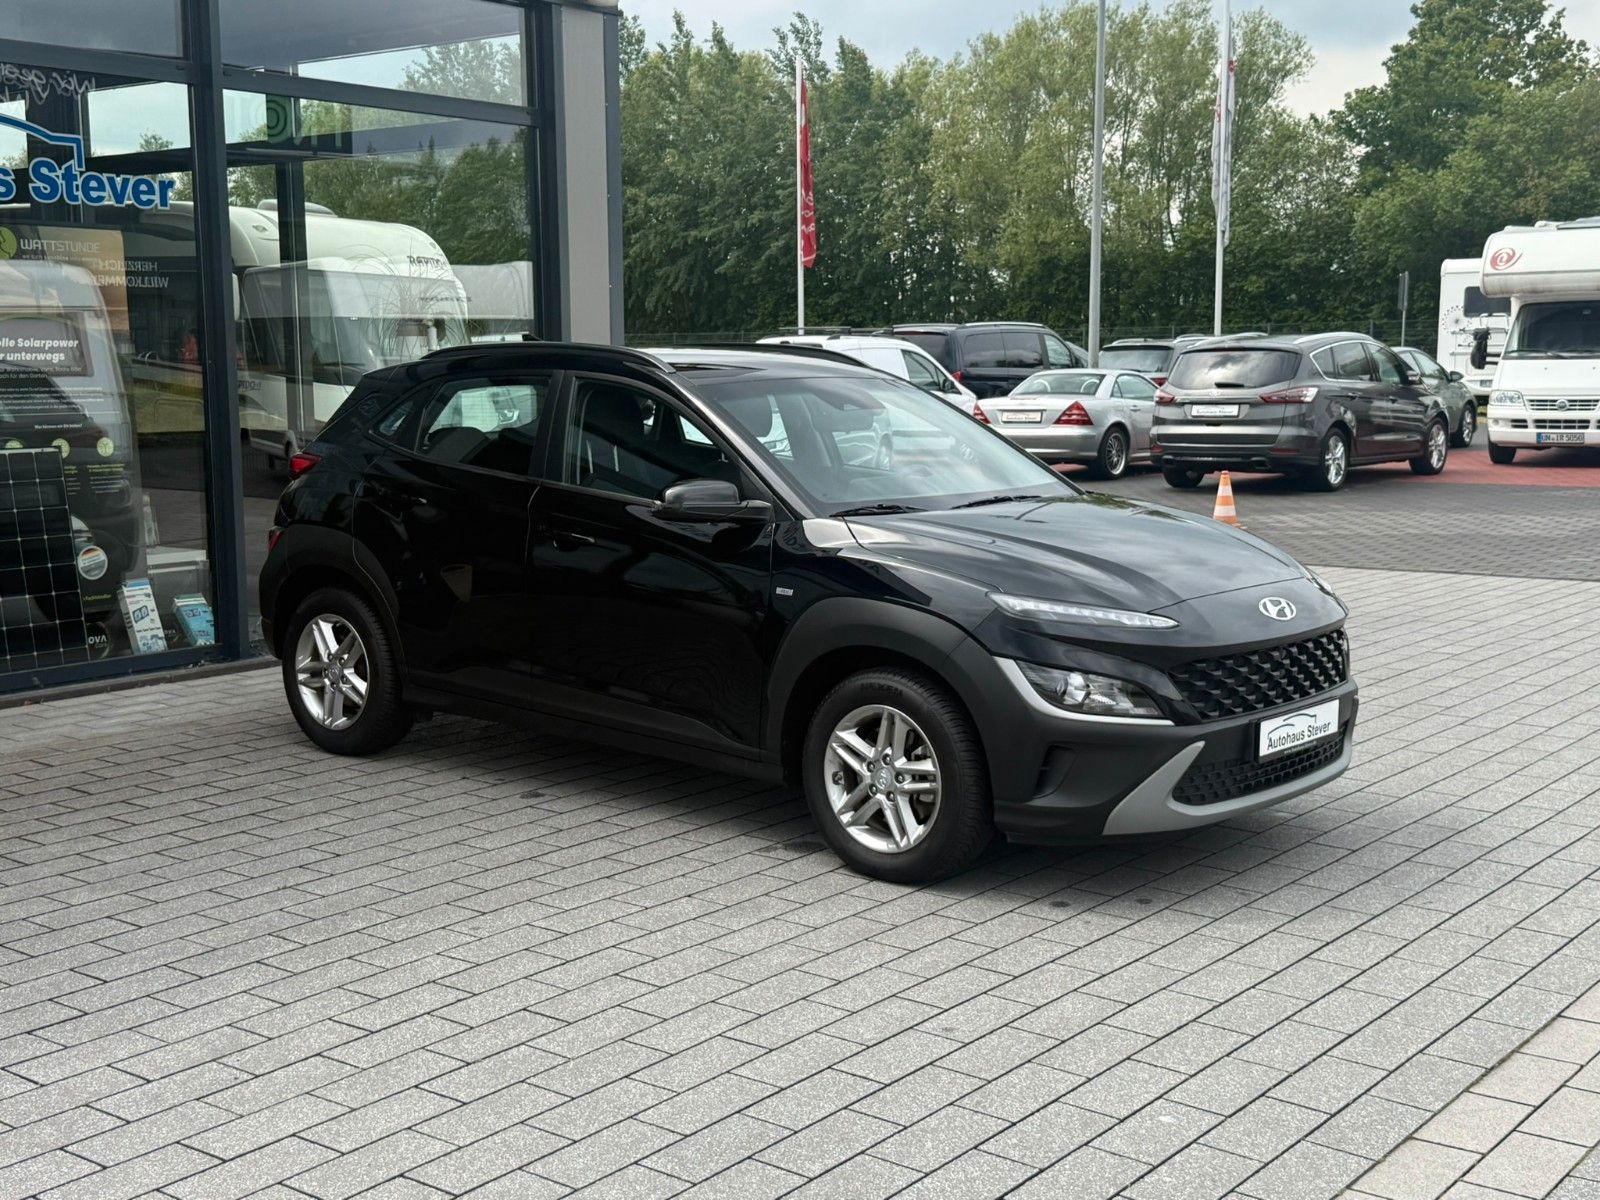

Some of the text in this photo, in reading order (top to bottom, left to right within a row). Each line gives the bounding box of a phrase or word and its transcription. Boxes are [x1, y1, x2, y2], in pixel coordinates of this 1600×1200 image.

[29, 157, 175, 210] Stever
[20, 238, 101, 253] WATTSTUNDE
[0, 338, 79, 350] lle Solarpower
[6, 352, 65, 363] unterwegs
[88, 634, 107, 645] OVA
[1267, 730, 1305, 750] Autohaus
[1307, 722, 1331, 739] Stever
